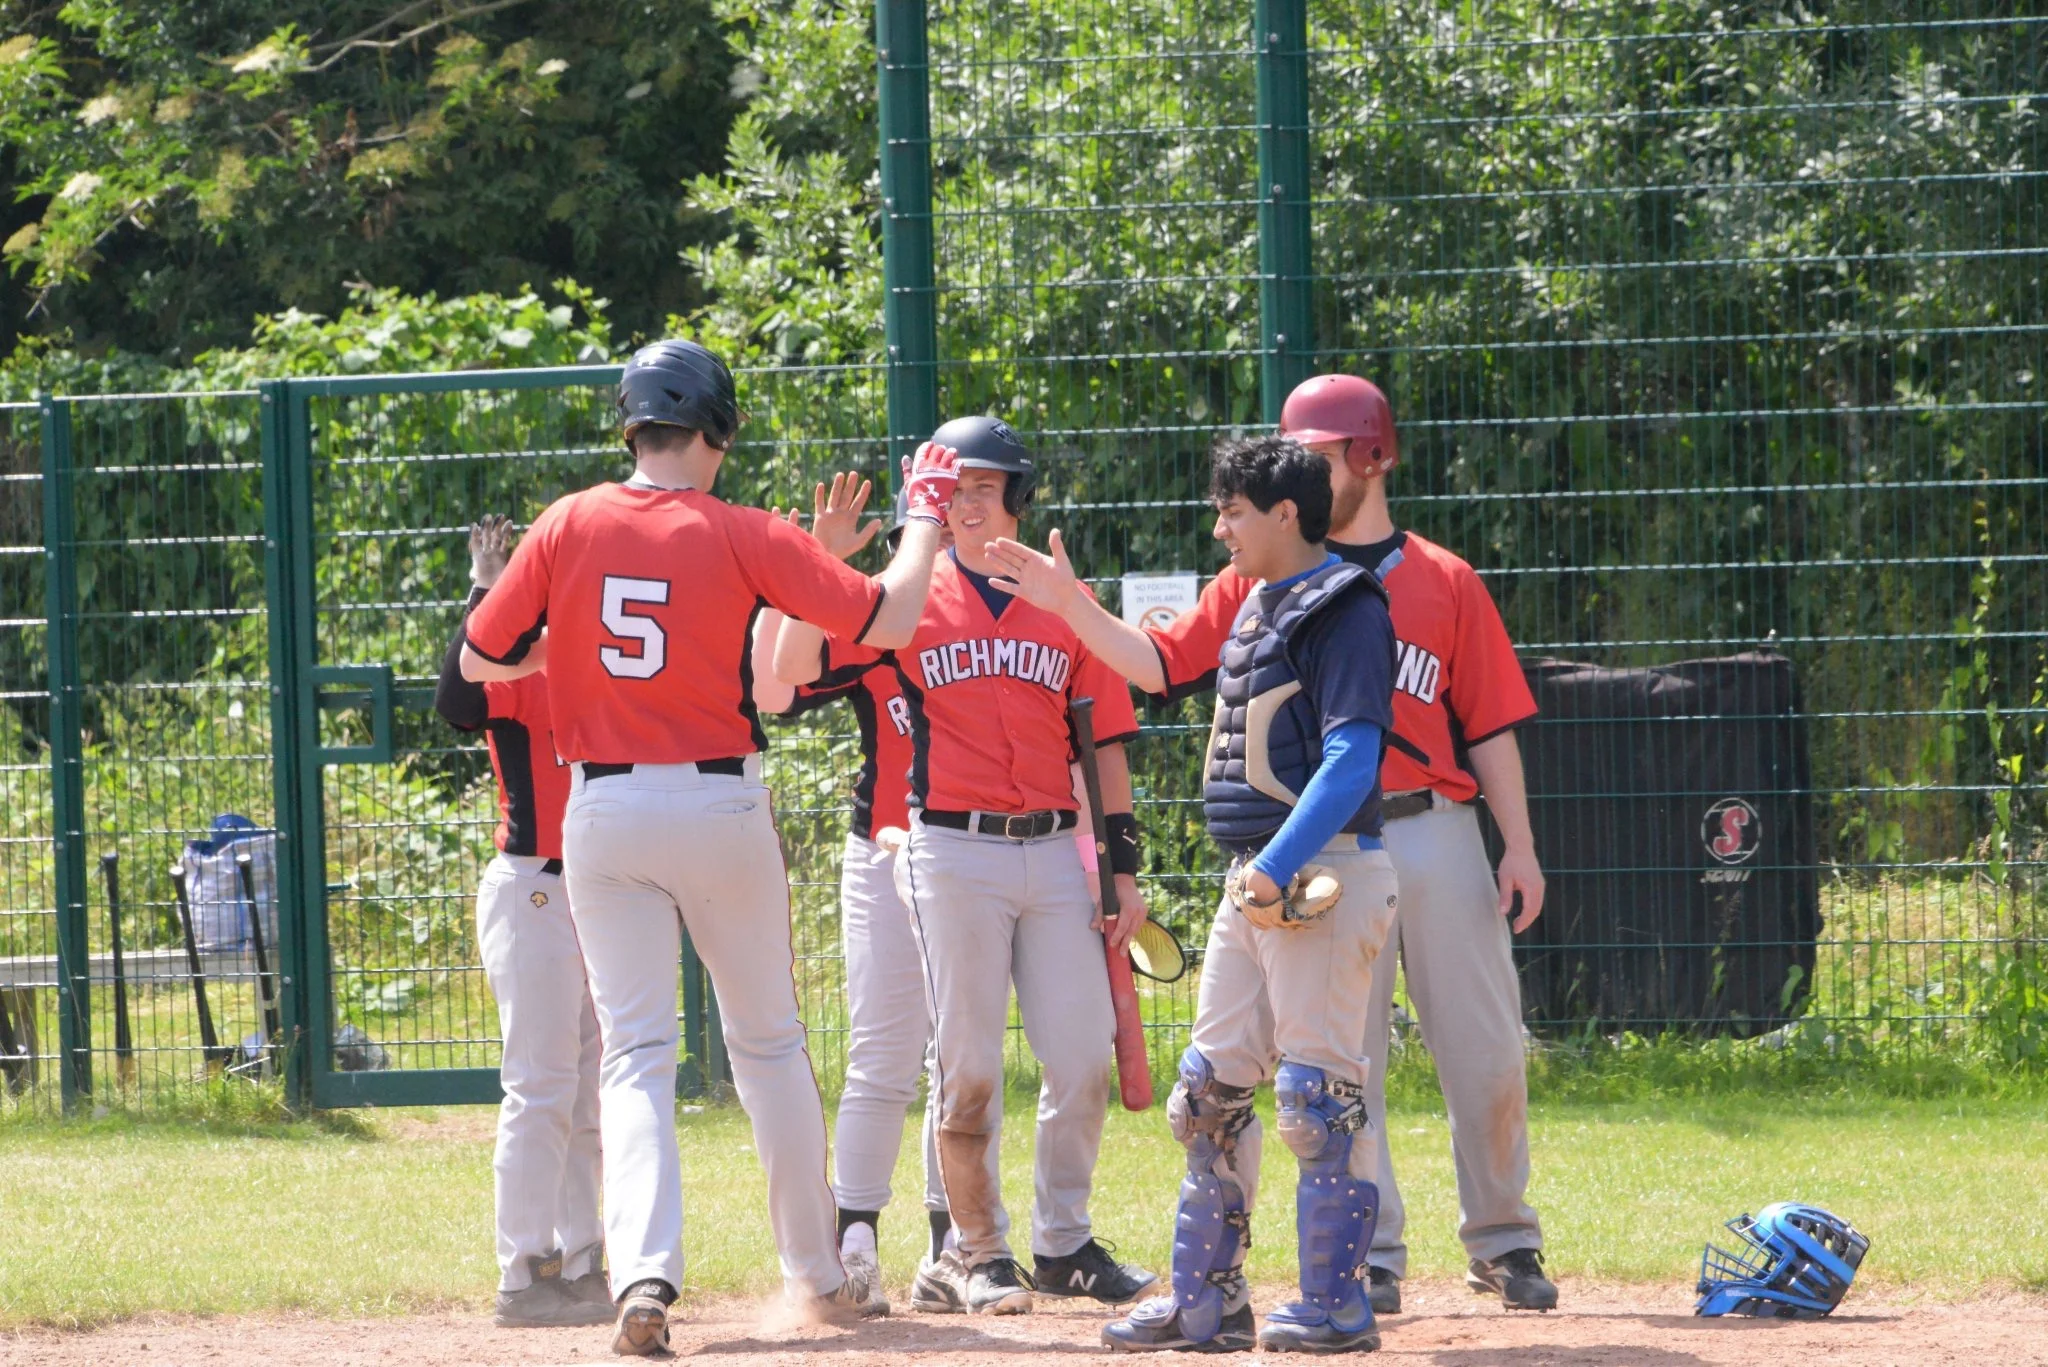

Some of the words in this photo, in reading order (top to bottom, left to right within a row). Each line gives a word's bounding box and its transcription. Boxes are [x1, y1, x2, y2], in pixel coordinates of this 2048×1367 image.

[1134, 583, 1146, 592] NO
[1147, 582, 1185, 591] FOOTBALL
[1136, 595, 1145, 604] IN
[1147, 595, 1162, 604] THIS
[1164, 593, 1185, 602] AREA
[599, 573, 671, 680] 5
[919, 637, 1070, 693] RICHMOND
[1068, 1269, 1098, 1292] N
